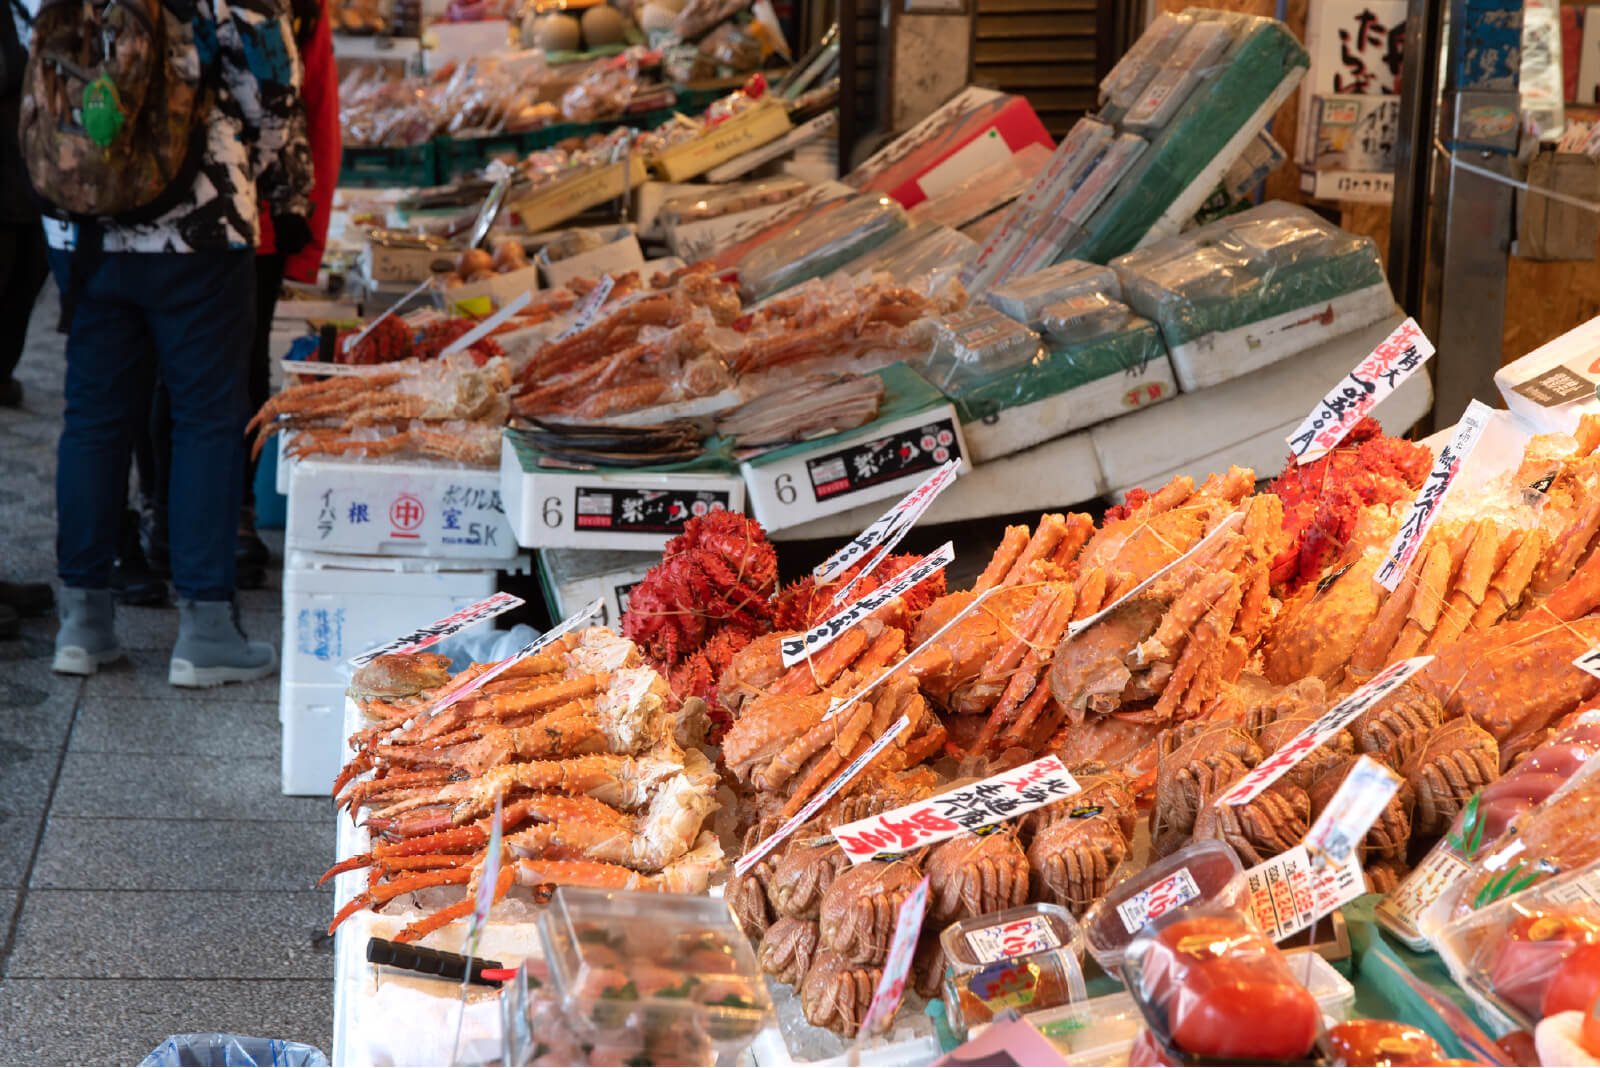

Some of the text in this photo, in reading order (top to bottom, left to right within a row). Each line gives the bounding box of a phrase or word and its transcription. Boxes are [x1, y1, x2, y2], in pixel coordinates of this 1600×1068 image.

[1379, 344, 1422, 389] 特大
[774, 473, 797, 505] 6
[542, 496, 563, 528] 6
[958, 778, 1070, 828] 北海道産
